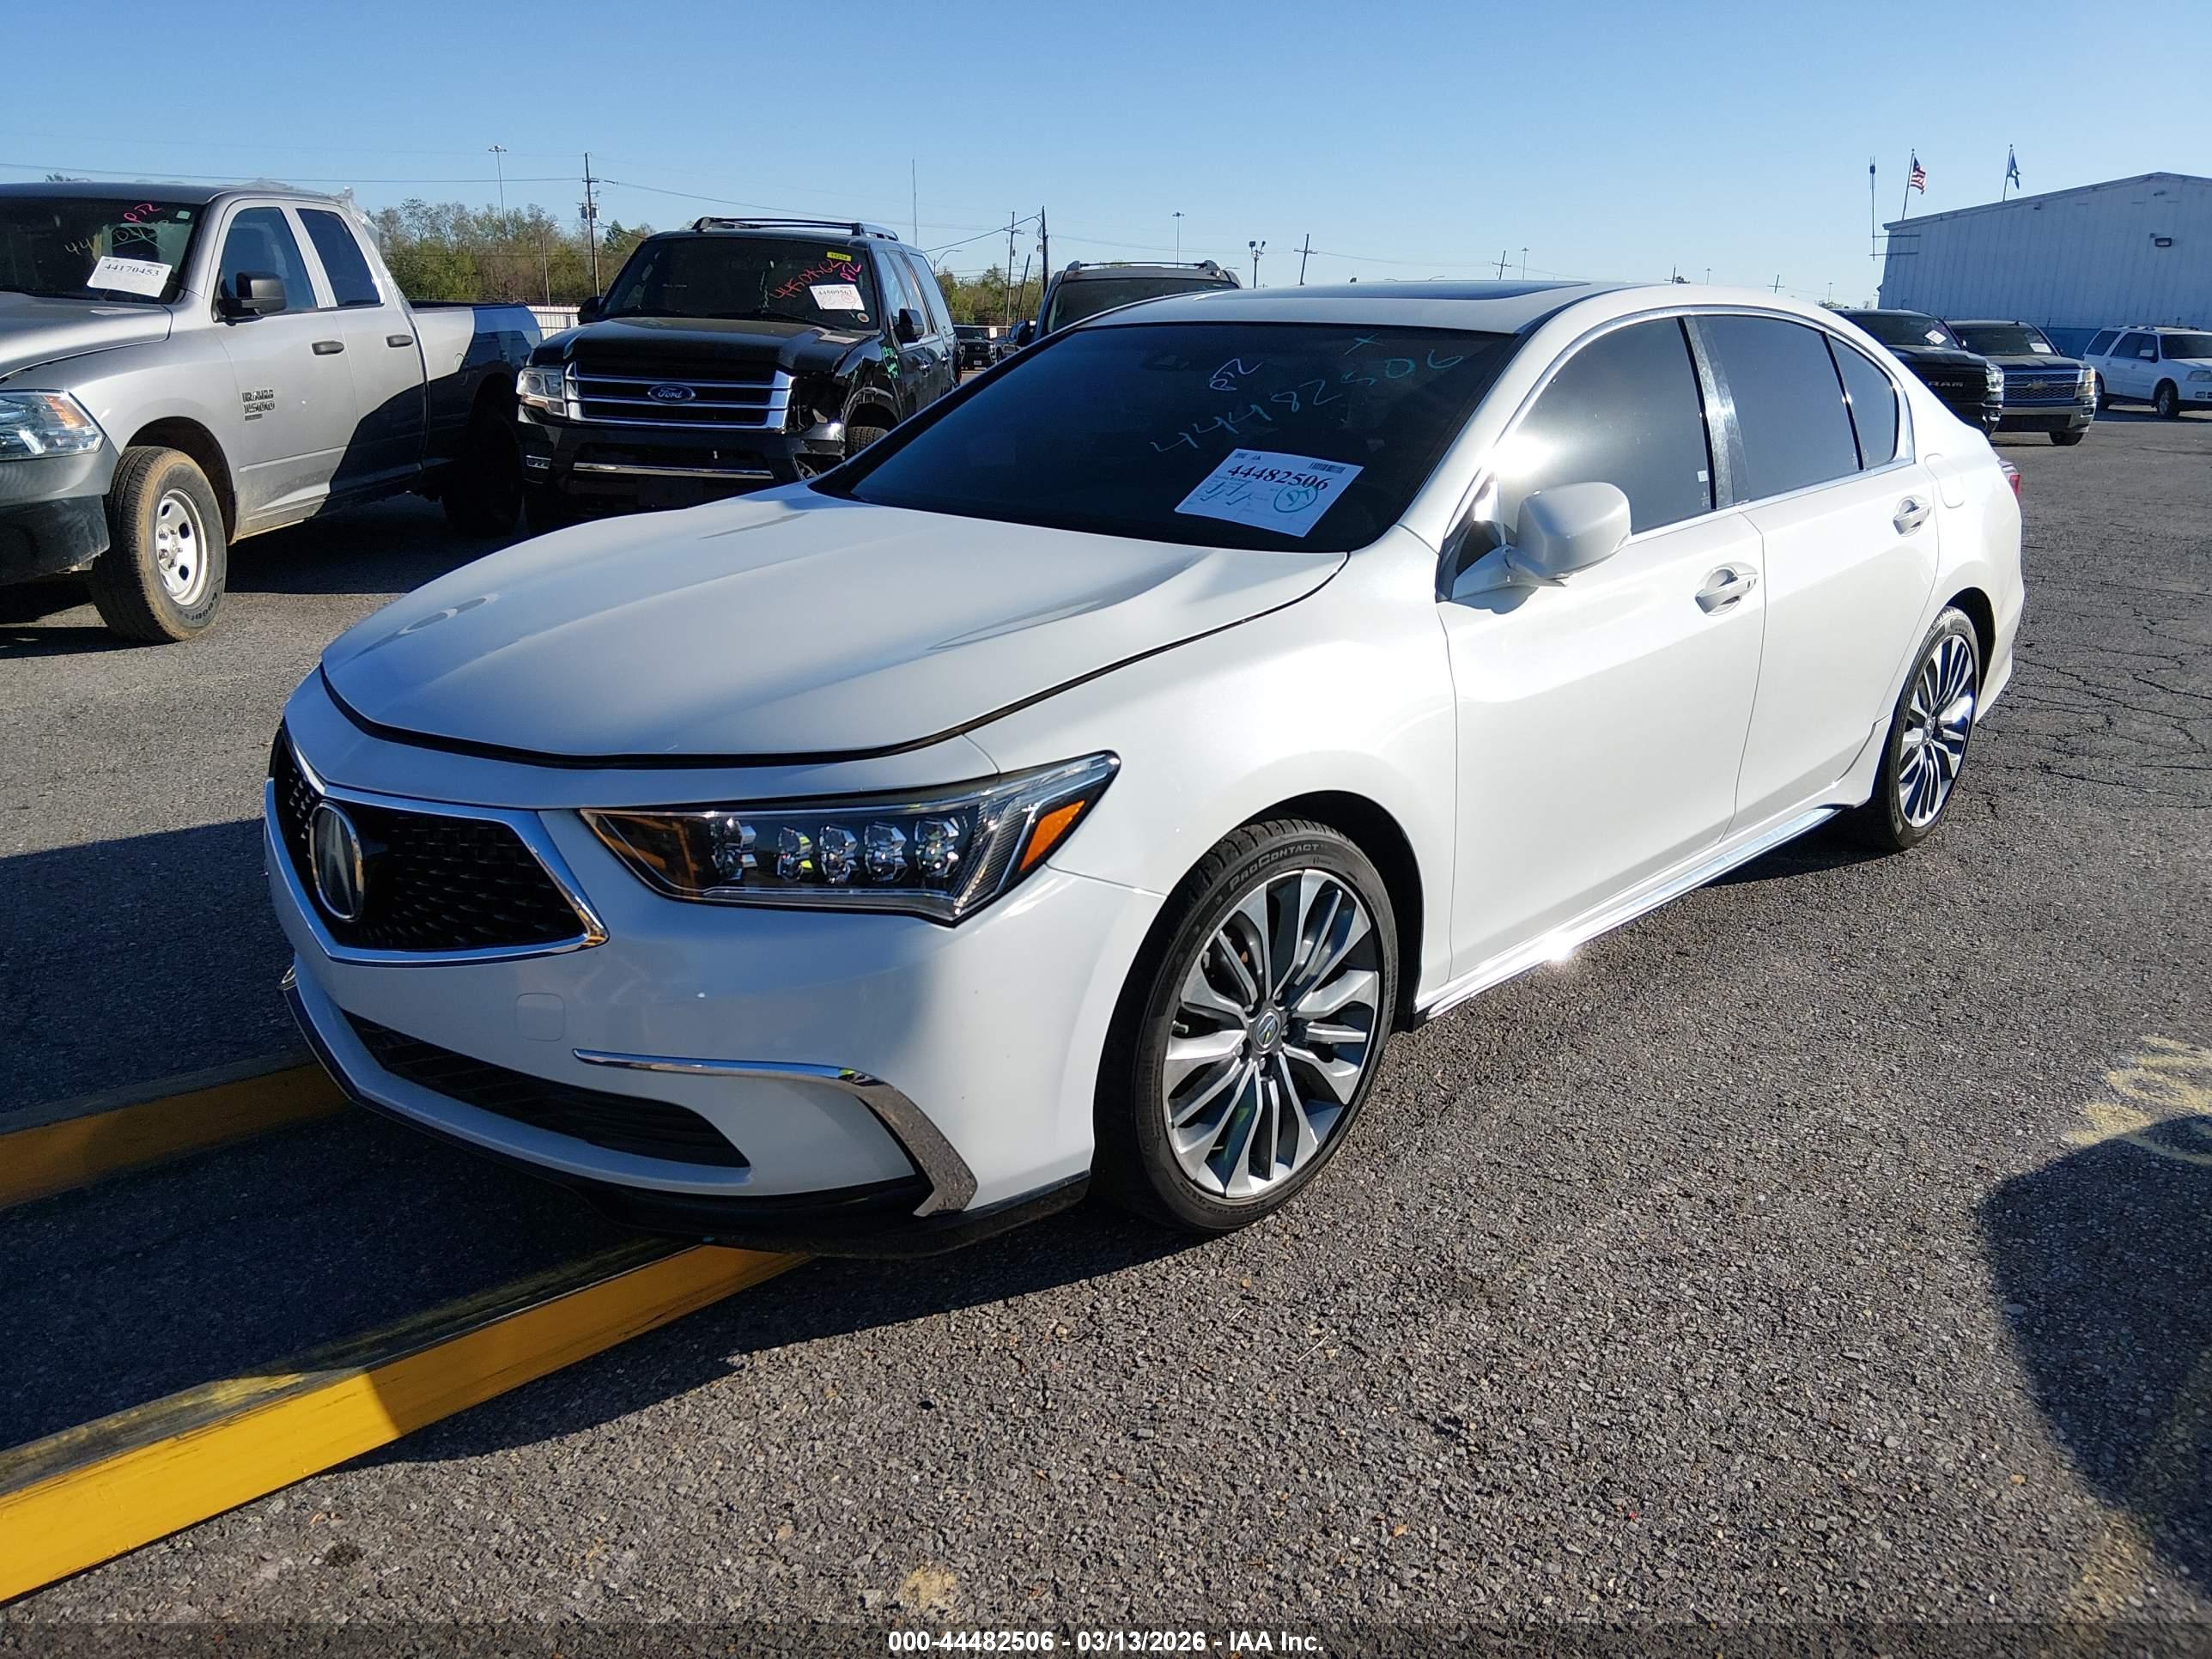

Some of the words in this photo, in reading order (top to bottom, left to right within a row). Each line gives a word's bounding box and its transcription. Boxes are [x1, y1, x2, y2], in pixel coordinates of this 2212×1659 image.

[104, 263, 161, 277] 44170453
[241, 389, 274, 403] RAM
[658, 387, 684, 398] Ford
[243, 400, 276, 414] 1500
[1149, 348, 1464, 453] 44482506
[1227, 465, 1333, 490] 44482506
